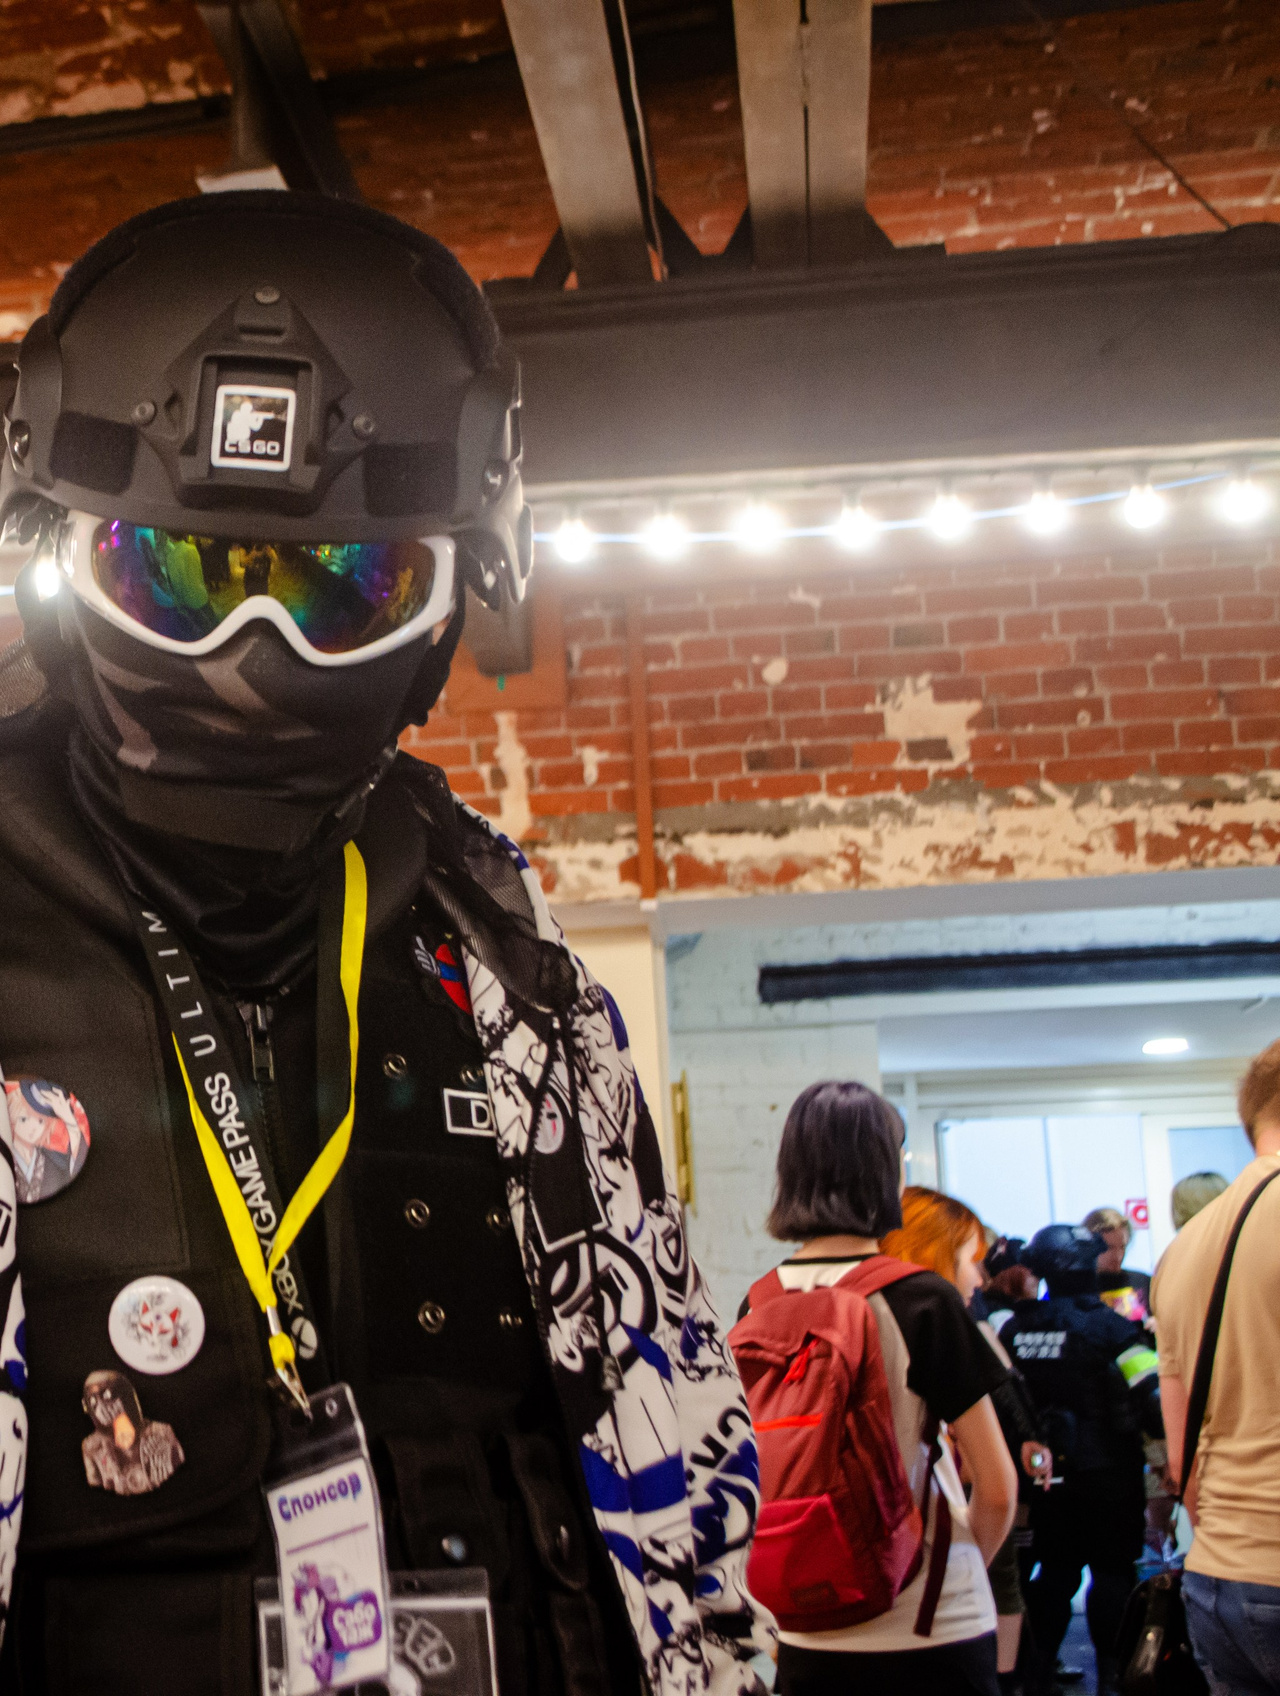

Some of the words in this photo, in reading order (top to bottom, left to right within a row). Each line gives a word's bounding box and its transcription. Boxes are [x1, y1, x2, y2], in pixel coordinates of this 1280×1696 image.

[204, 1071, 250, 1150] PASS
[228, 1145, 277, 1235] GAME
[277, 1472, 362, 1522] Спонсор
